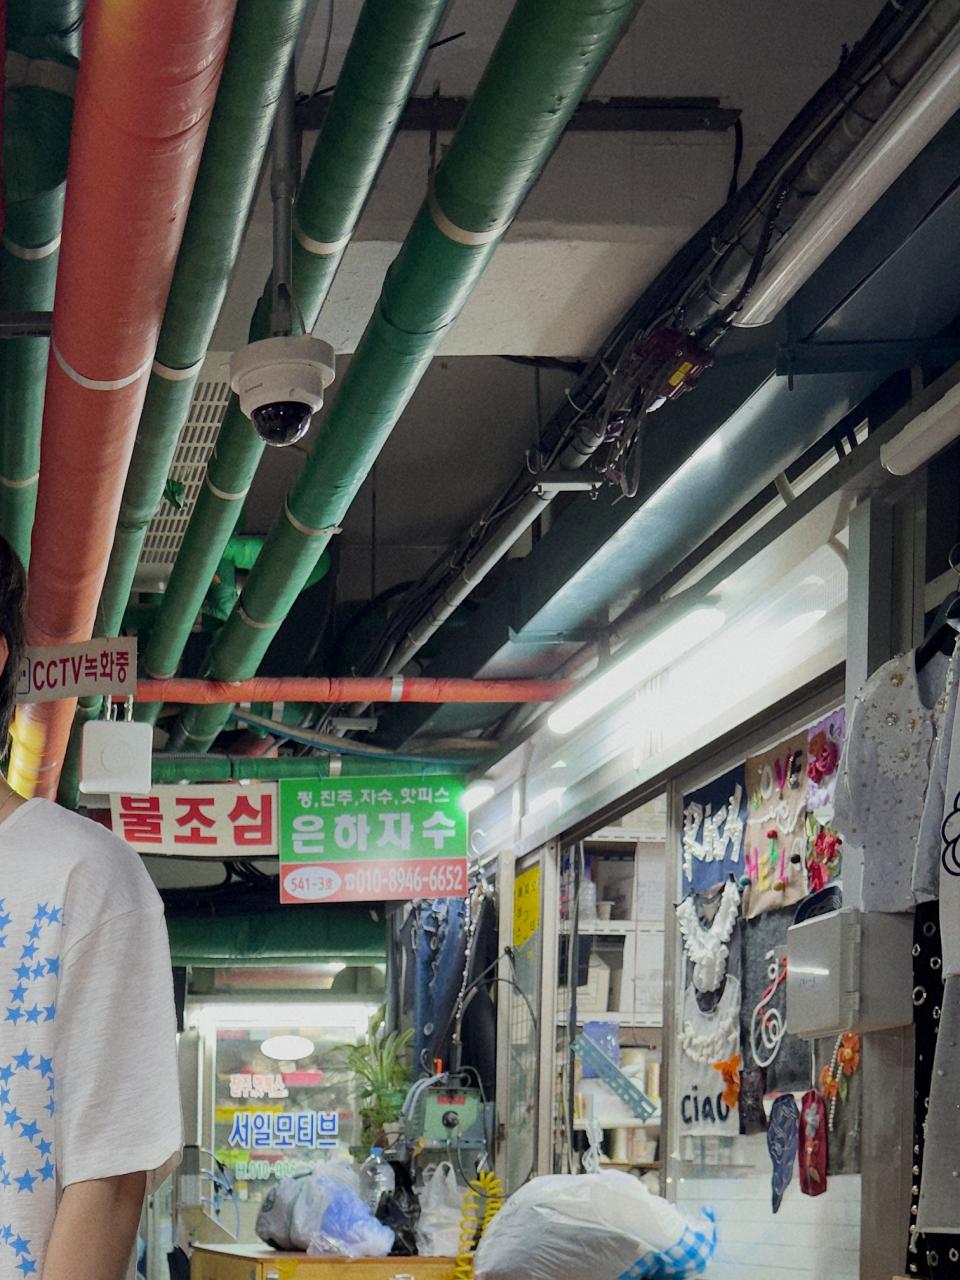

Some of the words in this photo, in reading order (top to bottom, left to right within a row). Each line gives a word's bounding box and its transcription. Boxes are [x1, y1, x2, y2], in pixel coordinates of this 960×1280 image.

[32, 650, 129, 691] CCTV녹화중
[119, 794, 273, 846] 불조심
[291, 810, 457, 854] 은하자수
[229, 1111, 338, 1148] 서일모티브
